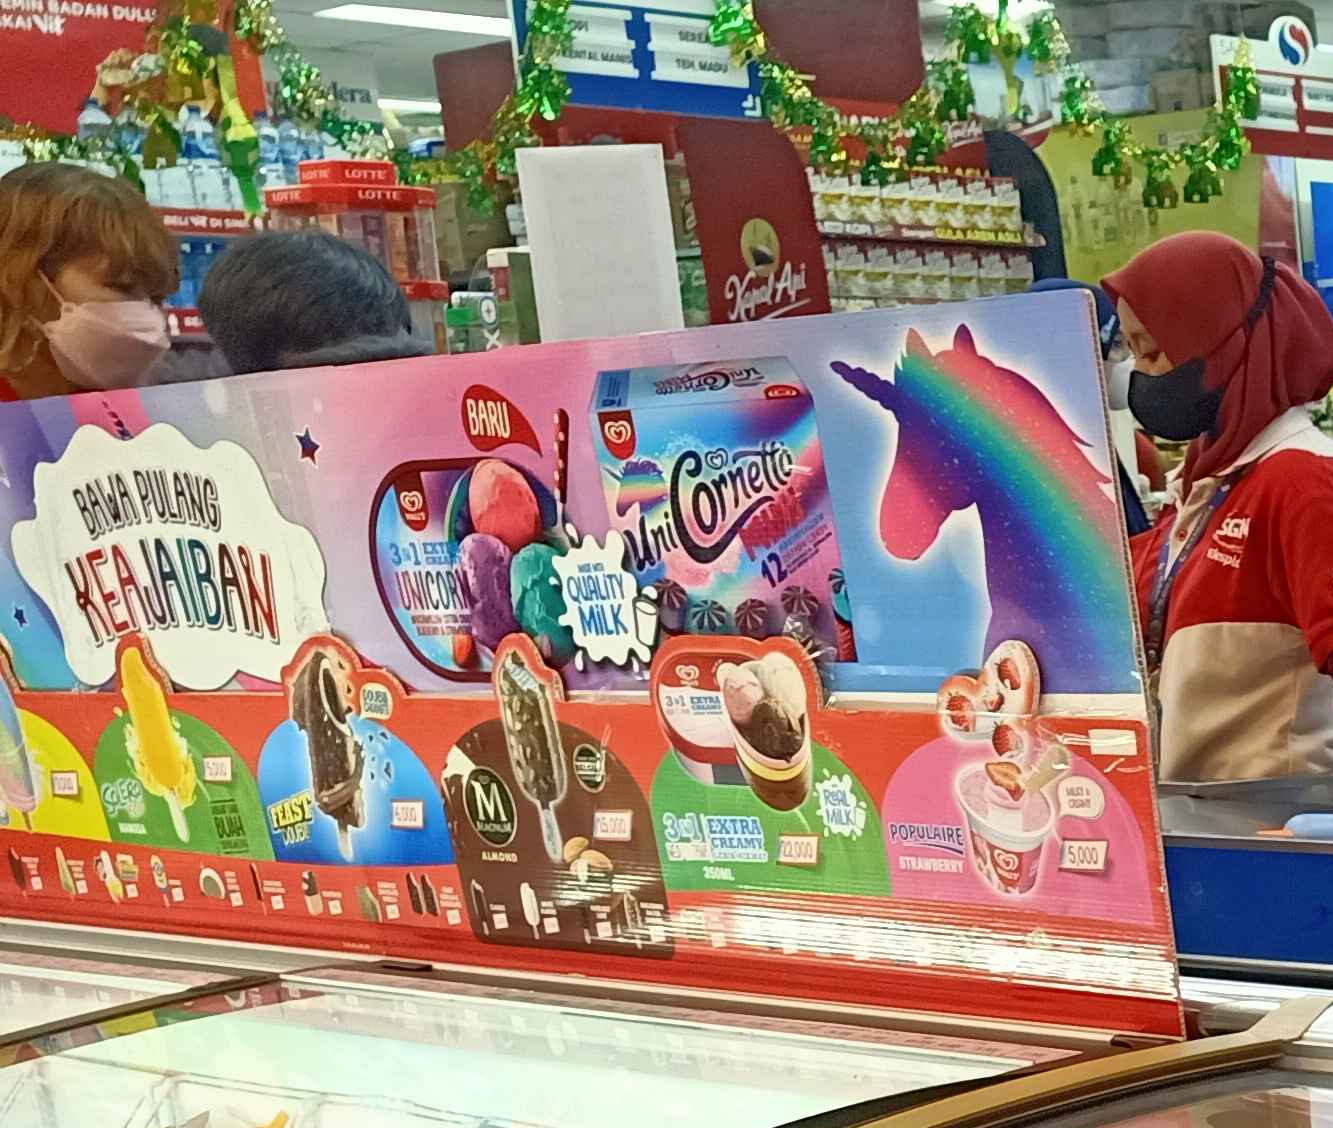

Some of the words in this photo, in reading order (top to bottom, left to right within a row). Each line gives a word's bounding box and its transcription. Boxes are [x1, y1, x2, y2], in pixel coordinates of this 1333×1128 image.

[48, 0, 108, 18] BADAN
[0, 14, 32, 30] KAI
[345, 169, 386, 181] LOTTE
[358, 190, 400, 201] LOTTE
[724, 270, 775, 321] Kapal
[772, 260, 808, 306] Api
[466, 399, 511, 439] BARU
[73, 474, 140, 537] BAWA
[139, 469, 222, 532] PULANG
[761, 551, 788, 588] 12
[64, 537, 281, 645] KEAJAIBAN
[271, 792, 312, 828] FEAST
[470, 780, 508, 821] M
[706, 818, 761, 836] EXTRA
[890, 823, 964, 847] POPULAIRE
[710, 836, 764, 850] CREAMY
[481, 851, 518, 864] ALMOND
[899, 855, 965, 874] STRAWBERRY
[1067, 846, 1099, 866] 5,000
